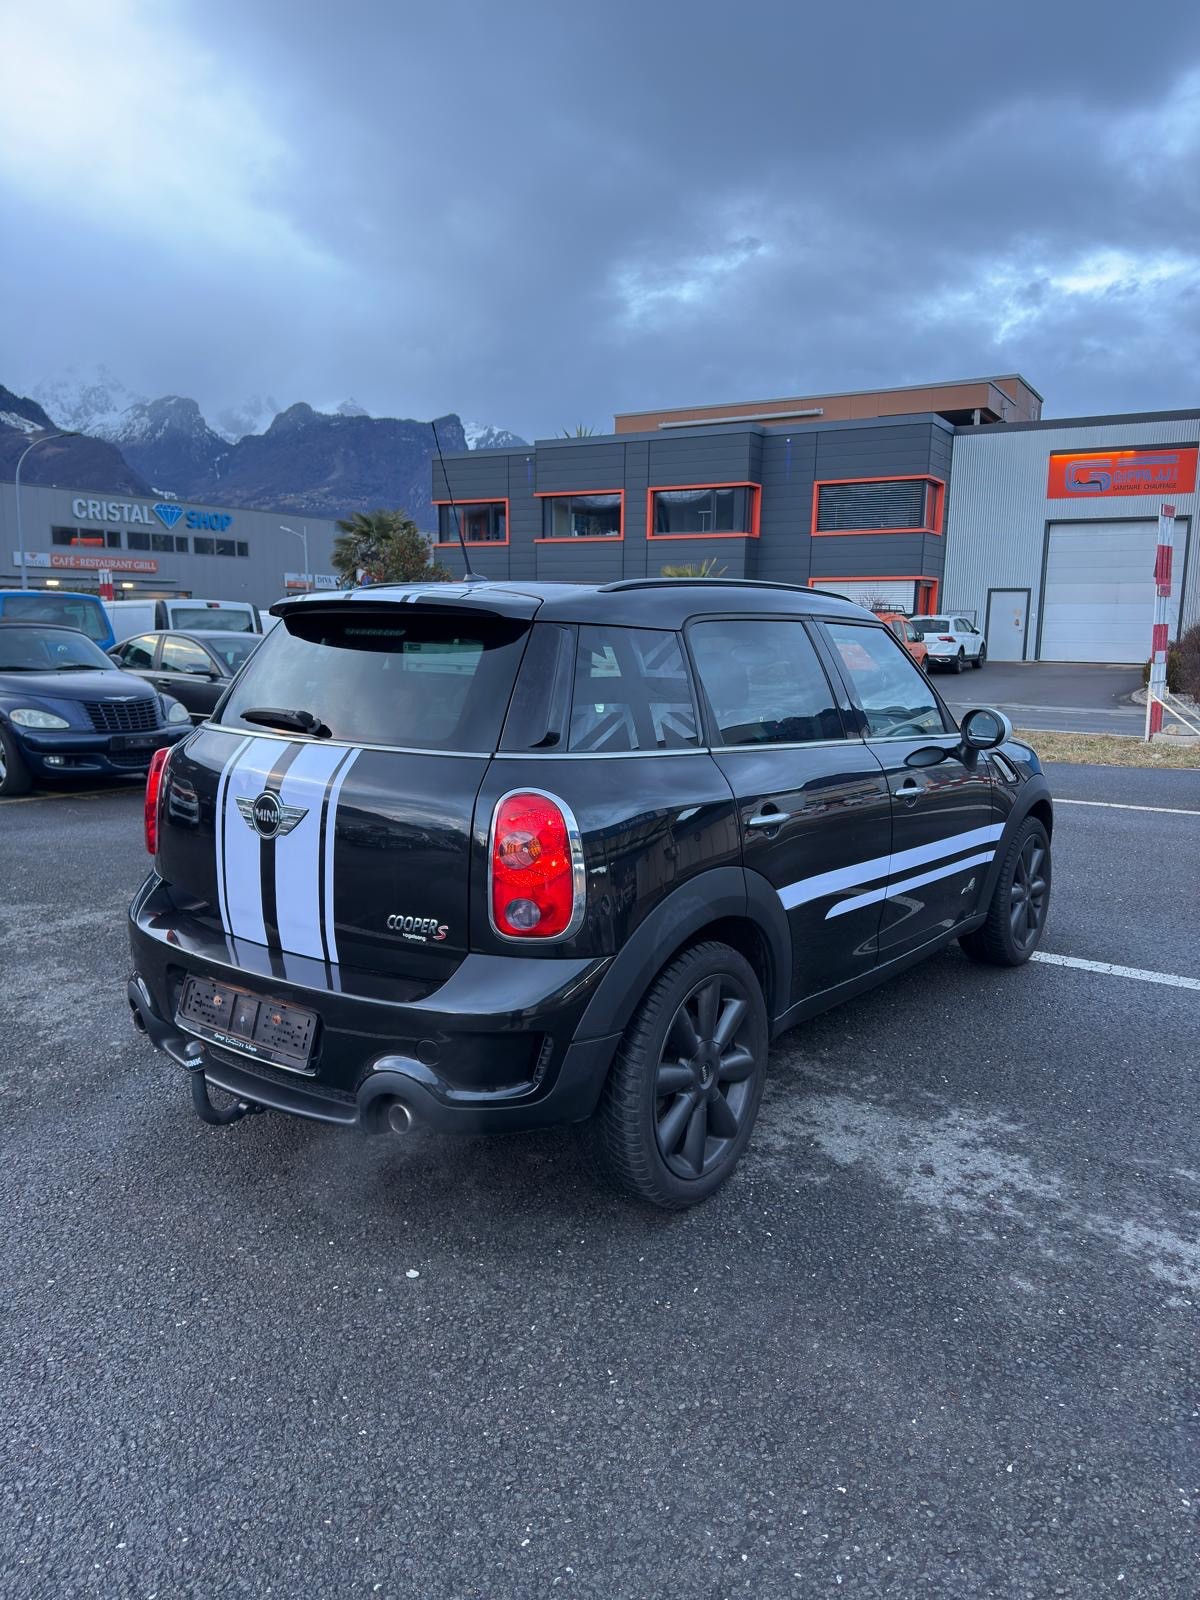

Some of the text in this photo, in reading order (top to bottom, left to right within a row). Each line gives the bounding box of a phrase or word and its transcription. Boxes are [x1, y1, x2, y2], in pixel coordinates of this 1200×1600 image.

[71, 498, 234, 532] CRISTAL SHOP
[133, 561, 157, 570] GRILL
[255, 807, 278, 823] MINI
[386, 914, 438, 935] COOPER
